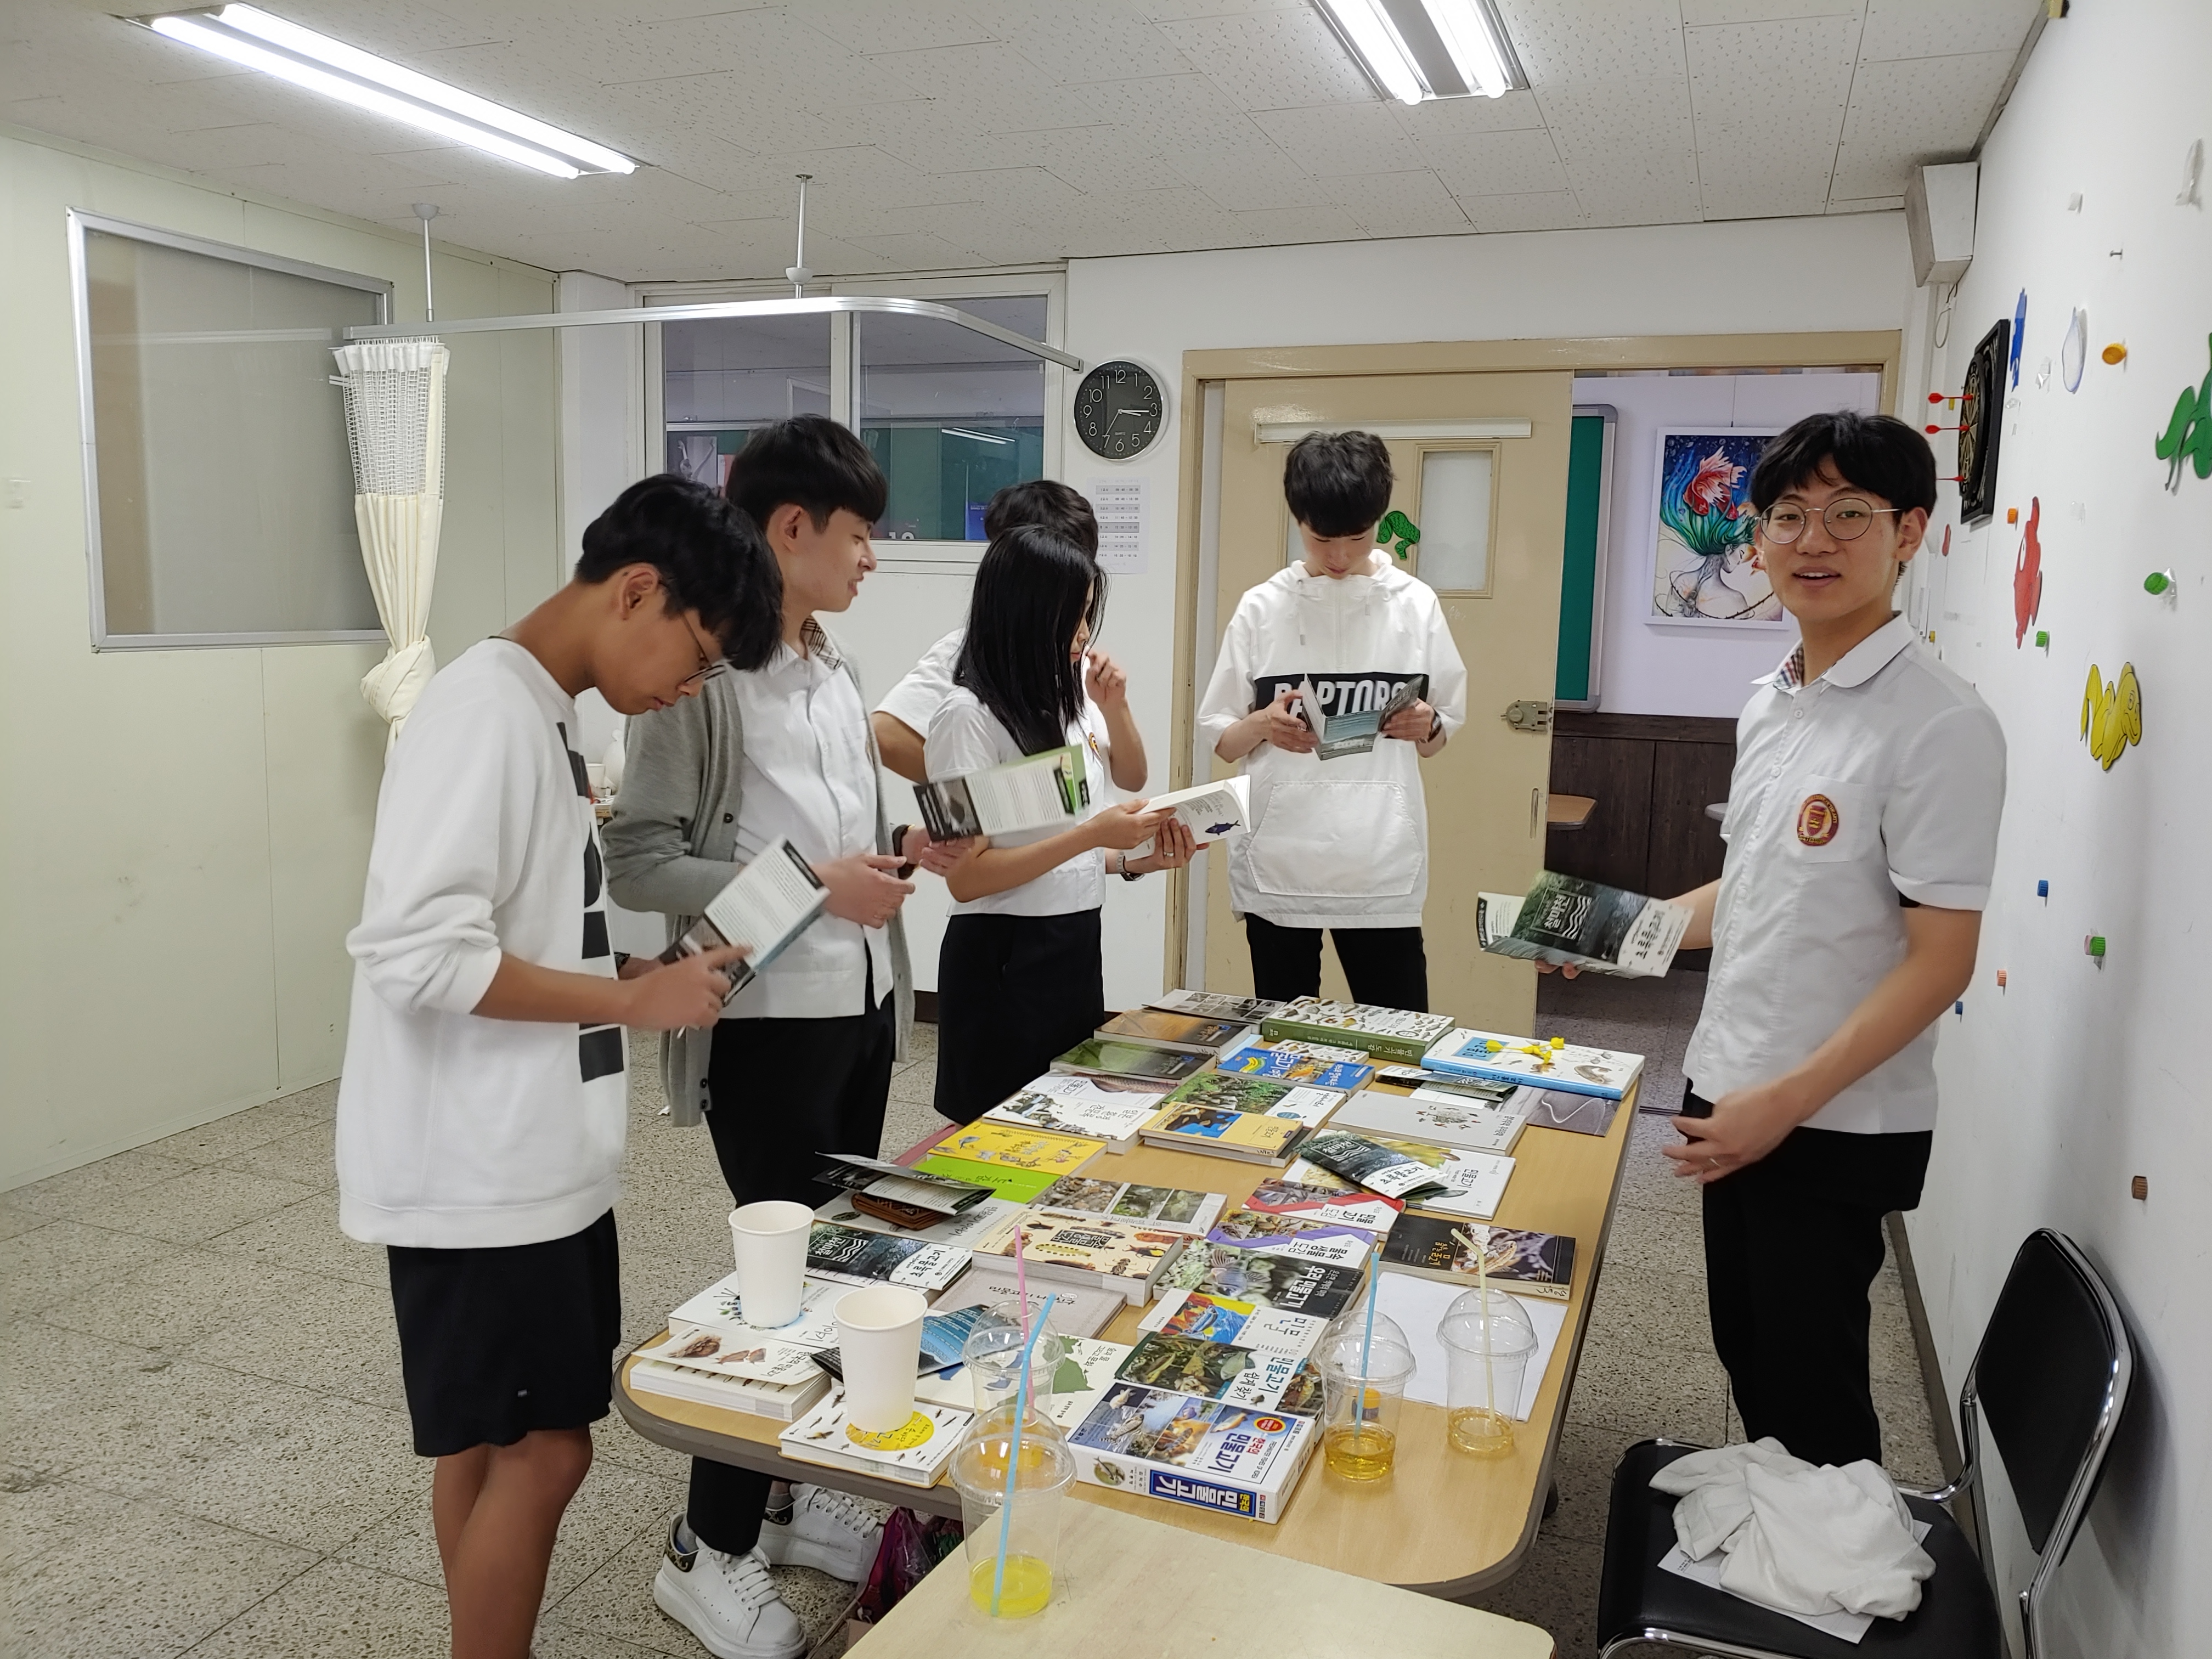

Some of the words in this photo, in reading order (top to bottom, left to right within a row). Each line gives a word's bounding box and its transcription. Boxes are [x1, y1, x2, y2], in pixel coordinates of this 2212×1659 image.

[1101, 375, 1110, 390] 11
[1115, 369, 1126, 383] 12
[1135, 373, 1138, 387] 1
[1089, 389, 1103, 403] 10
[1143, 386, 1153, 400] 2
[1083, 405, 1092, 419] 9
[1149, 403, 1158, 416] 3
[1089, 422, 1097, 436] 8
[1144, 421, 1152, 434] 4
[1102, 435, 1110, 448] 7
[1115, 438, 1125, 452] 6
[1131, 433, 1140, 447] 5
[1118, 1110, 1138, 1118] 일본
[1322, 1141, 1353, 1154] 철마천
[1380, 1166, 1423, 1184] 초록물고기
[1457, 1169, 1479, 1188] 민물고기
[1321, 1208, 1339, 1218] 도감
[947, 1221, 973, 1236] 이야기
[814, 1234, 847, 1257] 철마천
[1288, 1242, 1309, 1254] 도감
[1432, 1242, 1448, 1251] 춤추는
[910, 1249, 946, 1278] 초록물고기
[1429, 1252, 1450, 1265] 물고기
[1299, 1263, 1328, 1282] 우리
[1278, 1277, 1318, 1310] 민물고기
[787, 1352, 812, 1364] 한국의
[1239, 1372, 1260, 1386] 쉽게
[1258, 1358, 1294, 1393] 민물고기
[1230, 1386, 1252, 1400] 찾기
[1208, 1433, 1251, 1472] 민물고기
[1250, 1438, 1266, 1455] 한국의
[1154, 1475, 1240, 1509] 민물고기
[1238, 1493, 1251, 1513] 한국의
